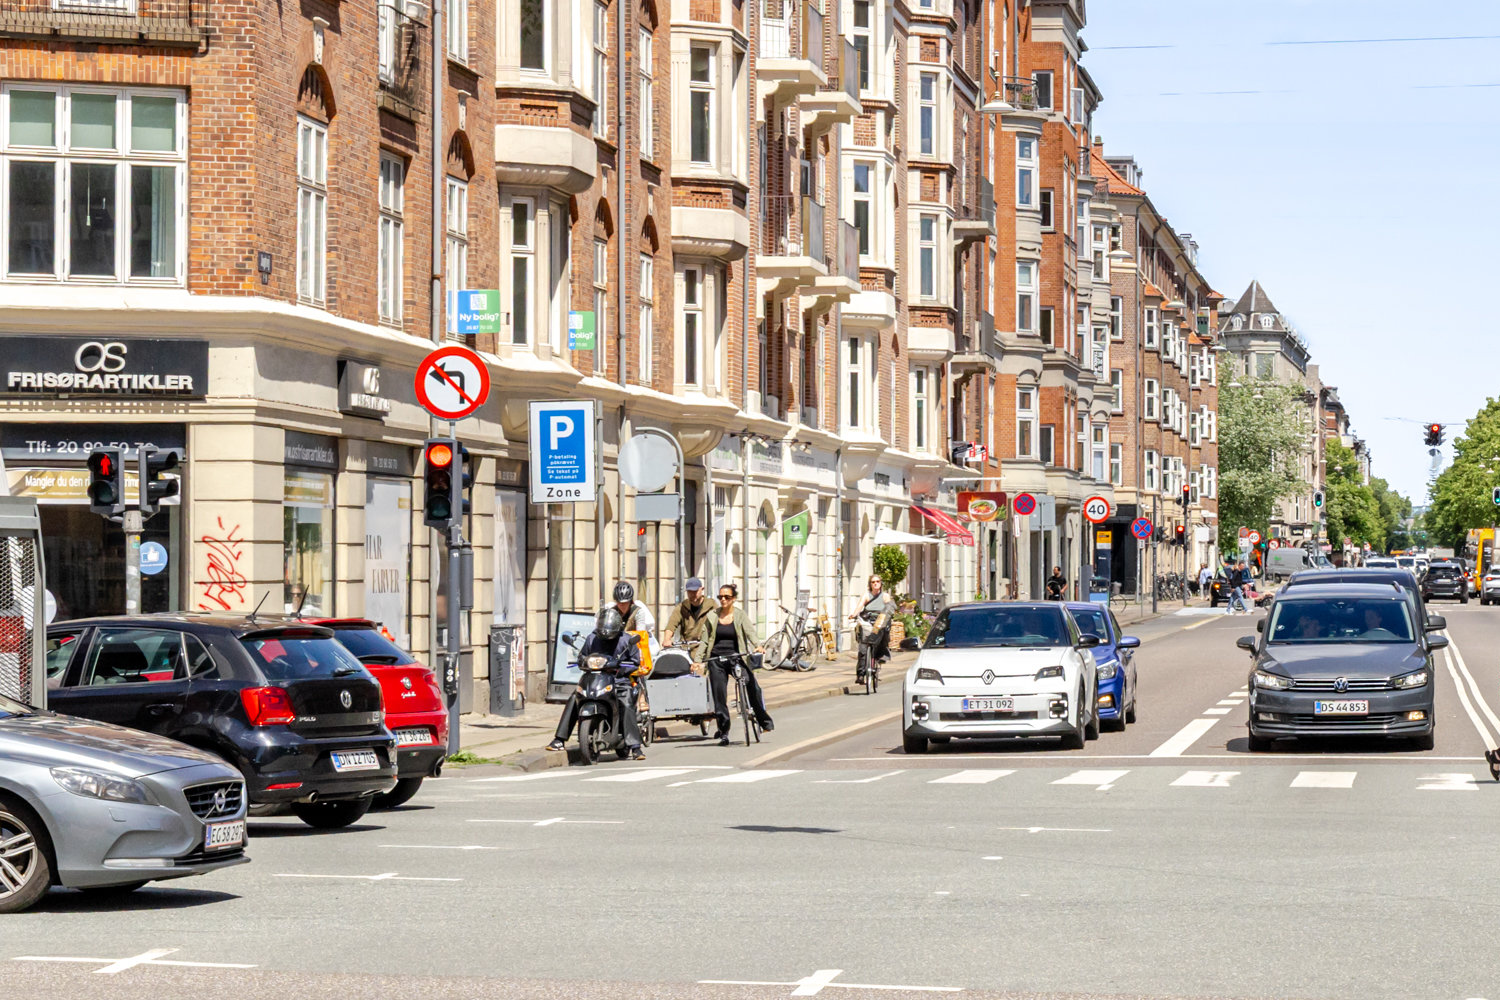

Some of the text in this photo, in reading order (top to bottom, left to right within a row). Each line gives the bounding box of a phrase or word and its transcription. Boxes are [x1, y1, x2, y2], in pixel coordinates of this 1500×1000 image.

[459, 313, 499, 322] Ny bolig?
[570, 332, 593, 340] bolig?
[74, 341, 128, 373] OS
[7, 371, 194, 390] FRISØRARTIKLER
[549, 415, 575, 450] P
[25, 440, 52, 453] Tlf:
[57, 441, 78, 454] 20
[25, 475, 55, 489] Mangler
[58, 476, 67, 487] du
[69, 476, 83, 487] den
[546, 487, 581, 497] Zone
[1088, 504, 1106, 515] 40
[969, 700, 1013, 709] ET 31 092
[1321, 703, 1367, 712] DS 44 853
[339, 751, 376, 765] DN 12 705
[211, 827, 222, 843] EG
